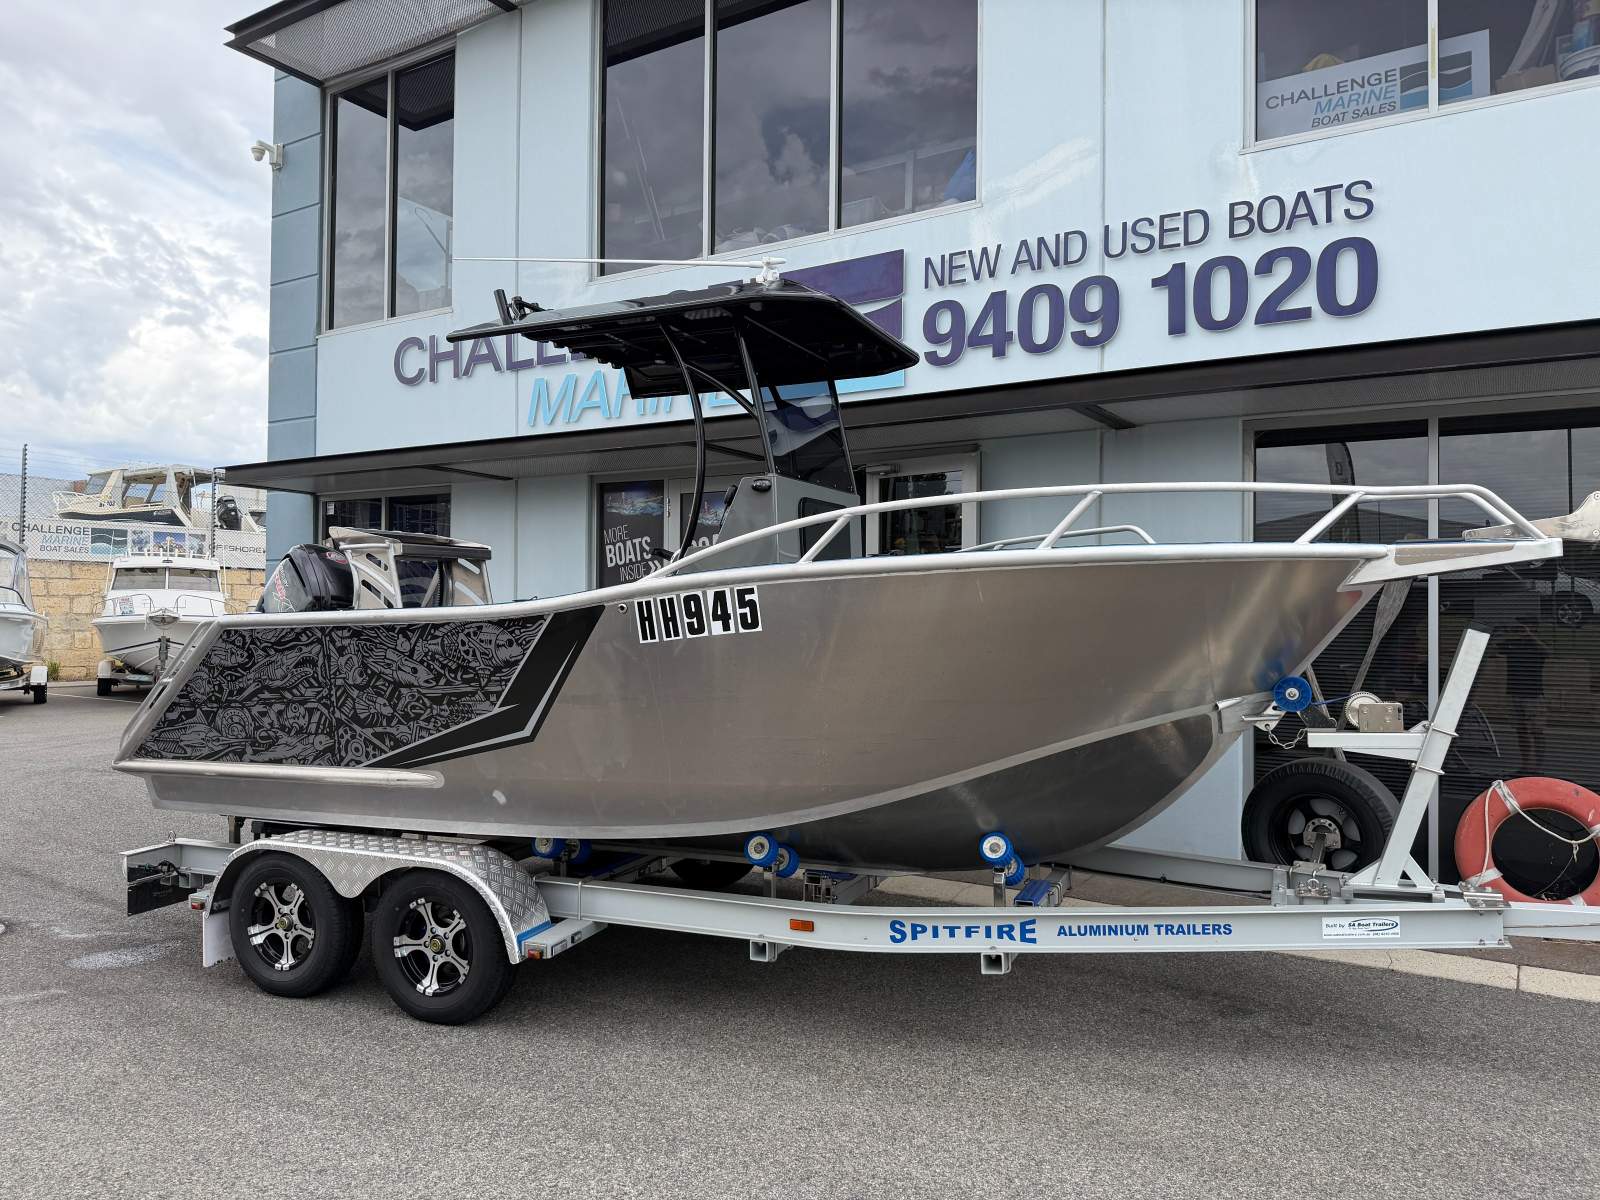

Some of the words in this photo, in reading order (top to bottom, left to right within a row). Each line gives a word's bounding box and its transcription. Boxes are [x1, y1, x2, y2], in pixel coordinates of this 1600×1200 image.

[1265, 68, 1398, 110] CHALLENGE
[1314, 83, 1398, 116] MARINE
[1311, 111, 1350, 128] BOAT
[1351, 100, 1398, 120] SALES
[923, 243, 1002, 290] NEW
[1010, 229, 1088, 275] AND
[1103, 208, 1210, 259] USED
[1228, 179, 1375, 239] BOATS
[922, 274, 1120, 367] 9409
[1151, 236, 1379, 336] 1020
[393, 333, 588, 387] CHALL
[11, 522, 90, 536] CHALLENGE
[41, 533, 89, 546] MARINE
[603, 524, 629, 545] MORE
[40, 544, 62, 552] BOAT
[63, 546, 90, 554] SALES
[605, 535, 652, 568] BOATS
[619, 561, 648, 583] INSIDE
[636, 586, 760, 641] HH945
[889, 918, 1037, 944] SPITFIRE
[1057, 923, 1149, 937] ALUMINIUM
[1154, 923, 1233, 936] TRAILERS
